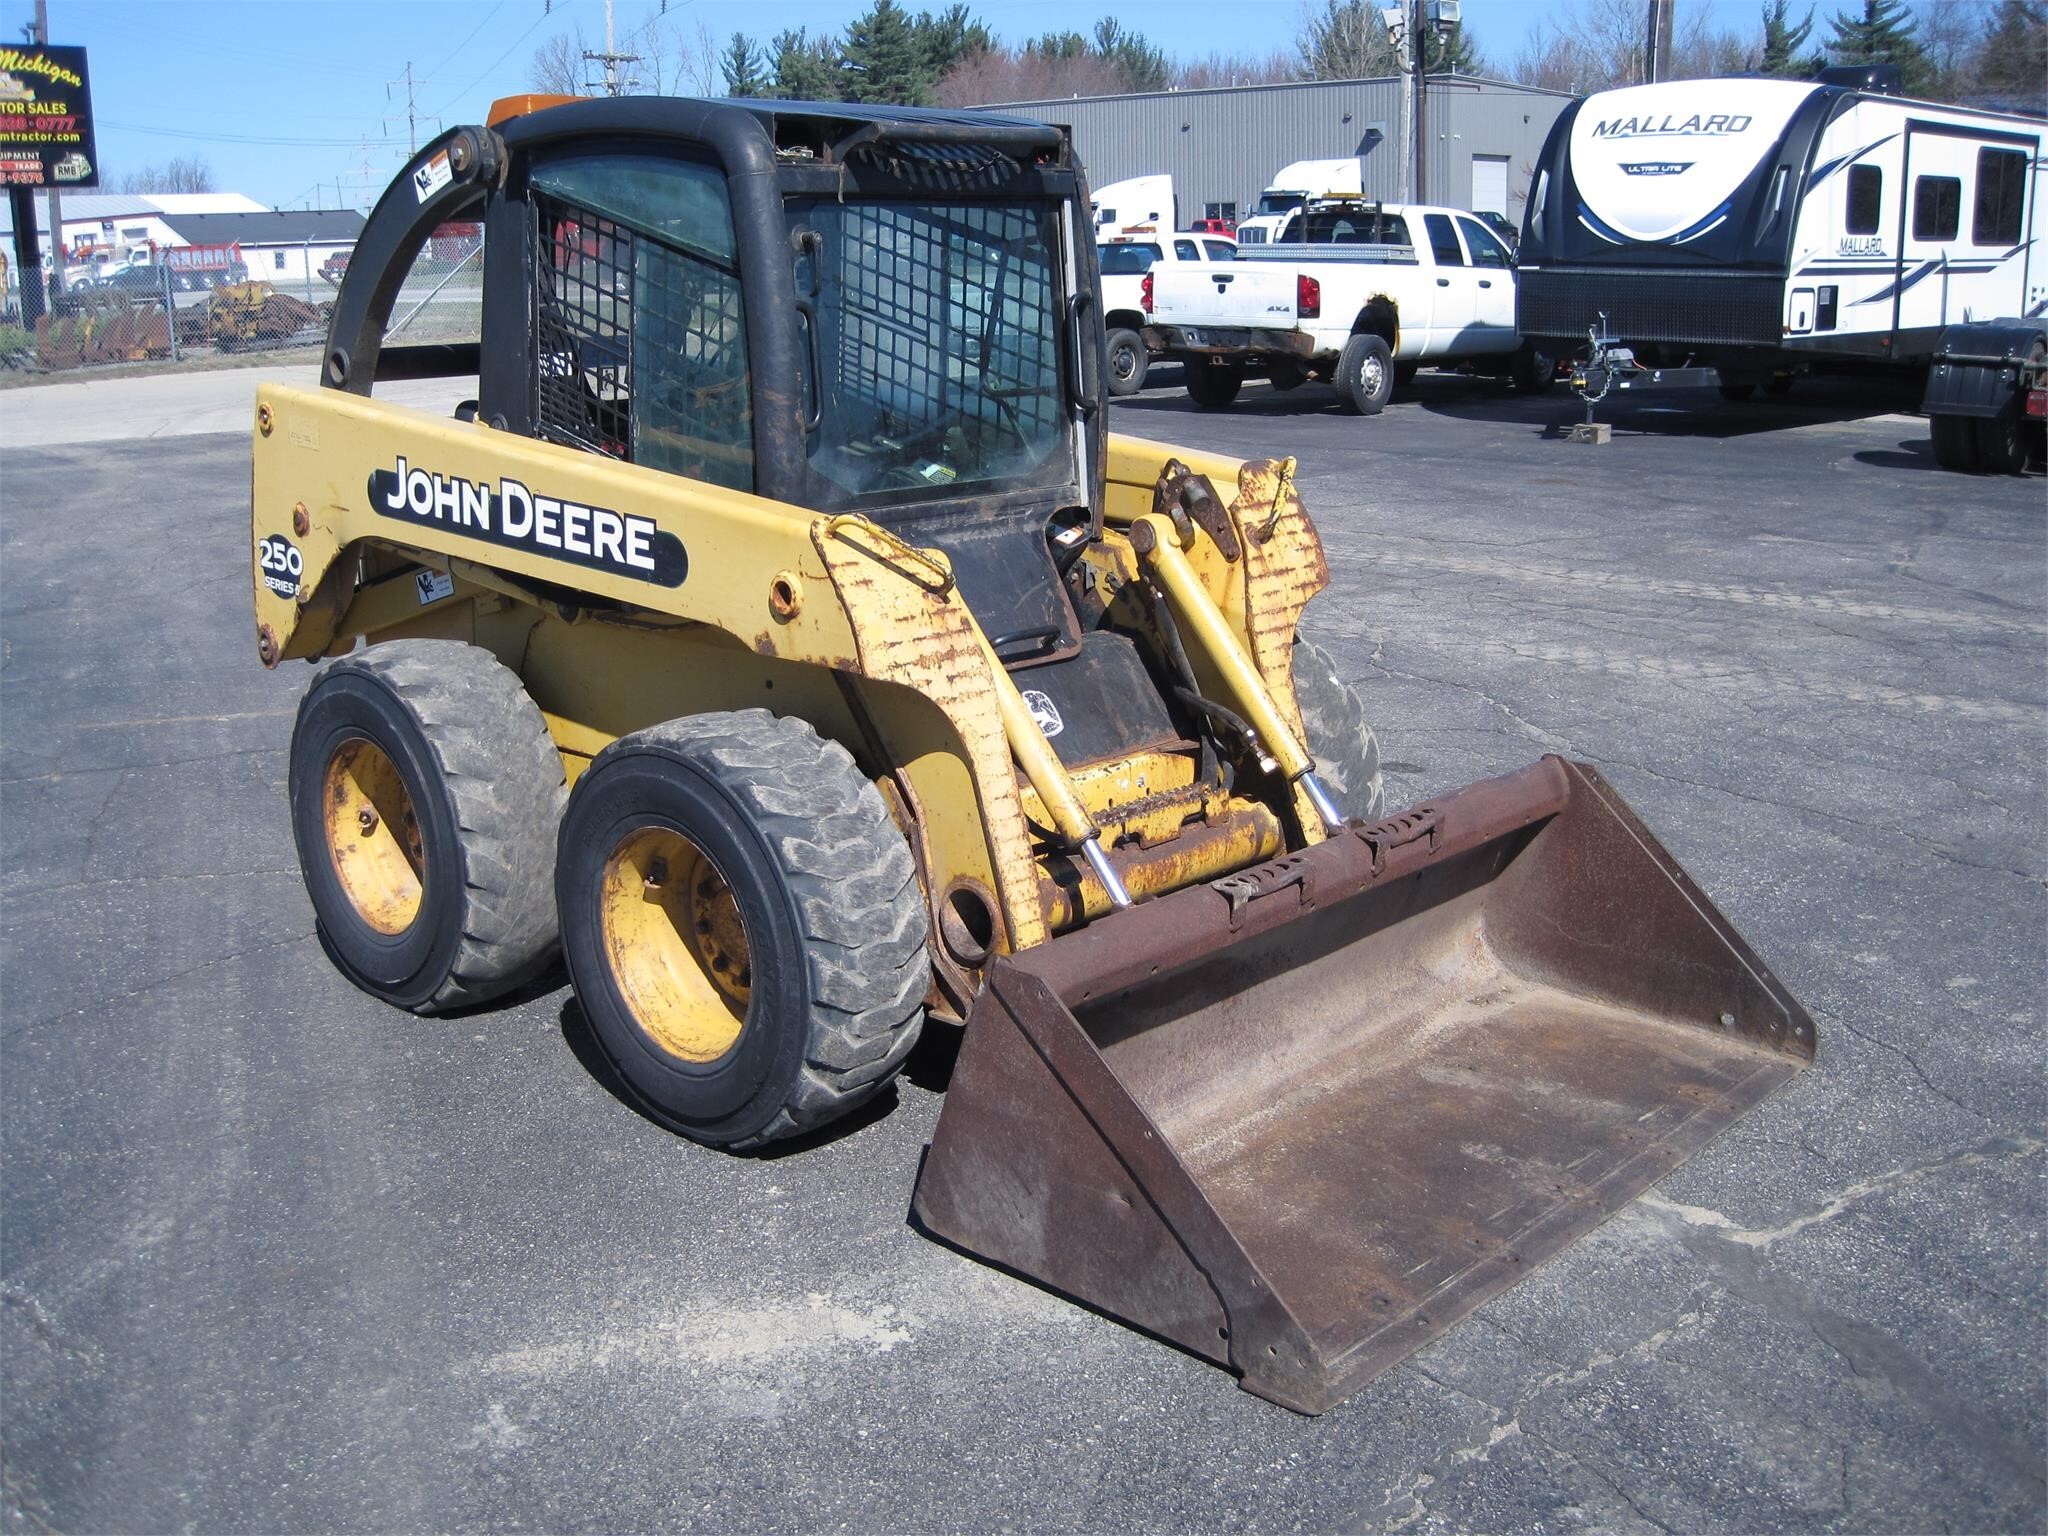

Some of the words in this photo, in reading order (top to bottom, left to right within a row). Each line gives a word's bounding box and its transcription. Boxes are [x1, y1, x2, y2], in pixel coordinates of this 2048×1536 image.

[0, 50, 82, 87] Michigan
[28, 102, 67, 115] SALES
[1592, 115, 1752, 138] MALLARD
[15, 162, 40, 170] TRADE
[57, 166, 77, 176] RMB
[1628, 165, 1659, 173] ULTRA
[1840, 238, 1882, 253] MALLARD
[387, 458, 490, 531] JOHN
[501, 478, 656, 571] DEERE
[259, 539, 303, 576] 250
[264, 575, 294, 594] SERIES
